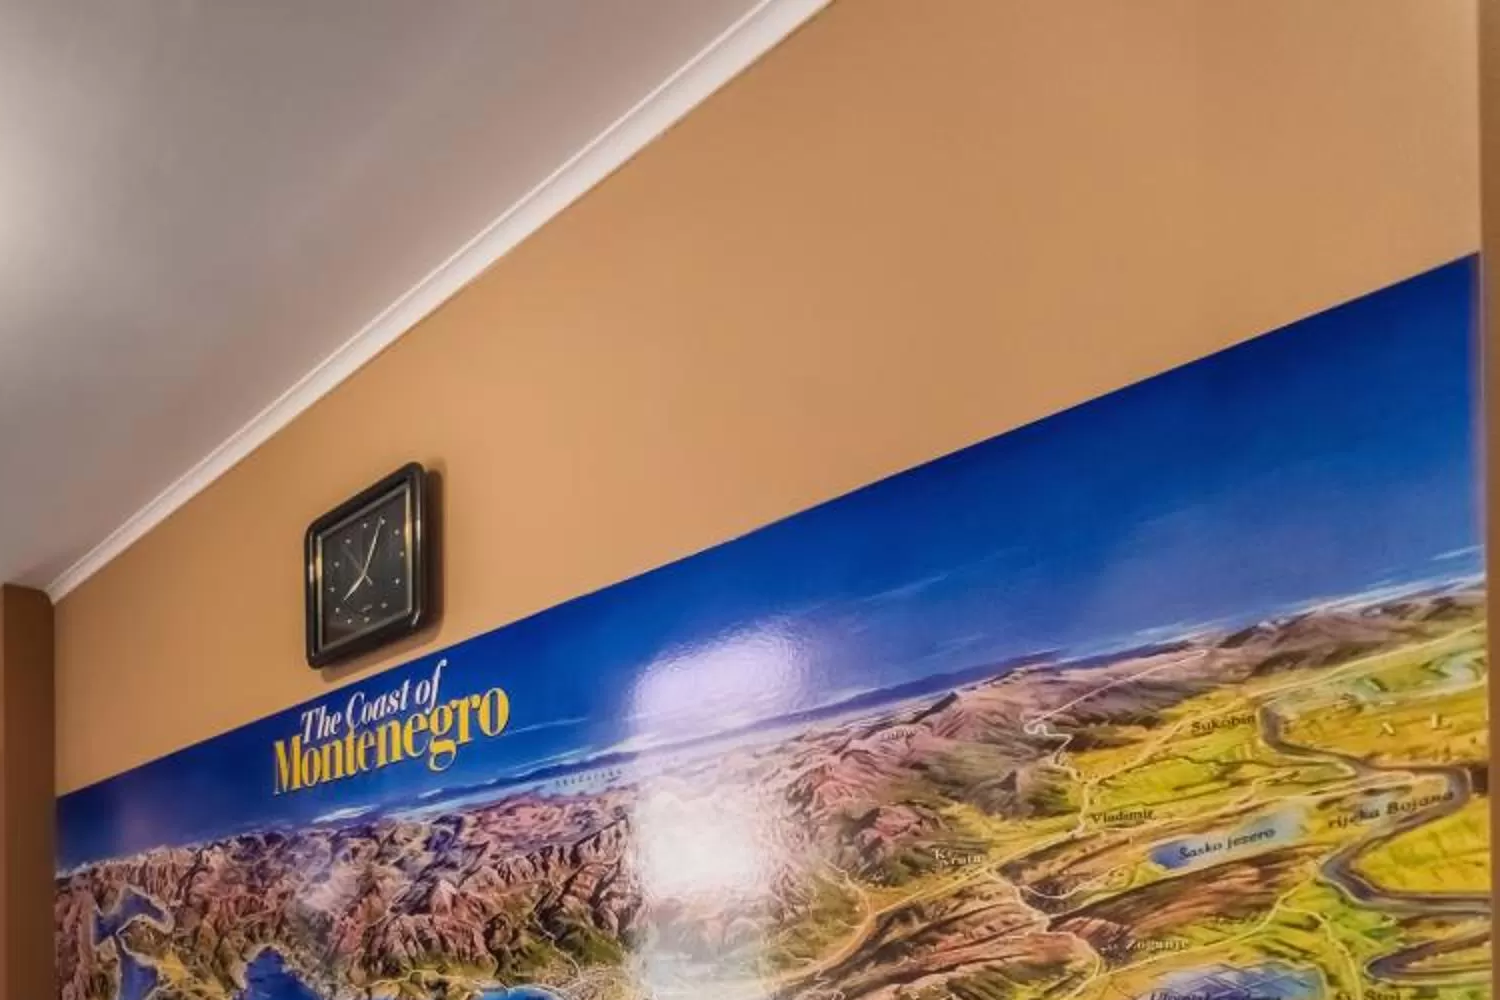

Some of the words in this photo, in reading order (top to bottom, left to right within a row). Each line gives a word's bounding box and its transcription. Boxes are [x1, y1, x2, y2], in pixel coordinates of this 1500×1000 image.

[272, 686, 510, 797] Montenegro
[300, 704, 342, 745] The
[346, 676, 411, 732] Coast
[414, 657, 448, 714] of
